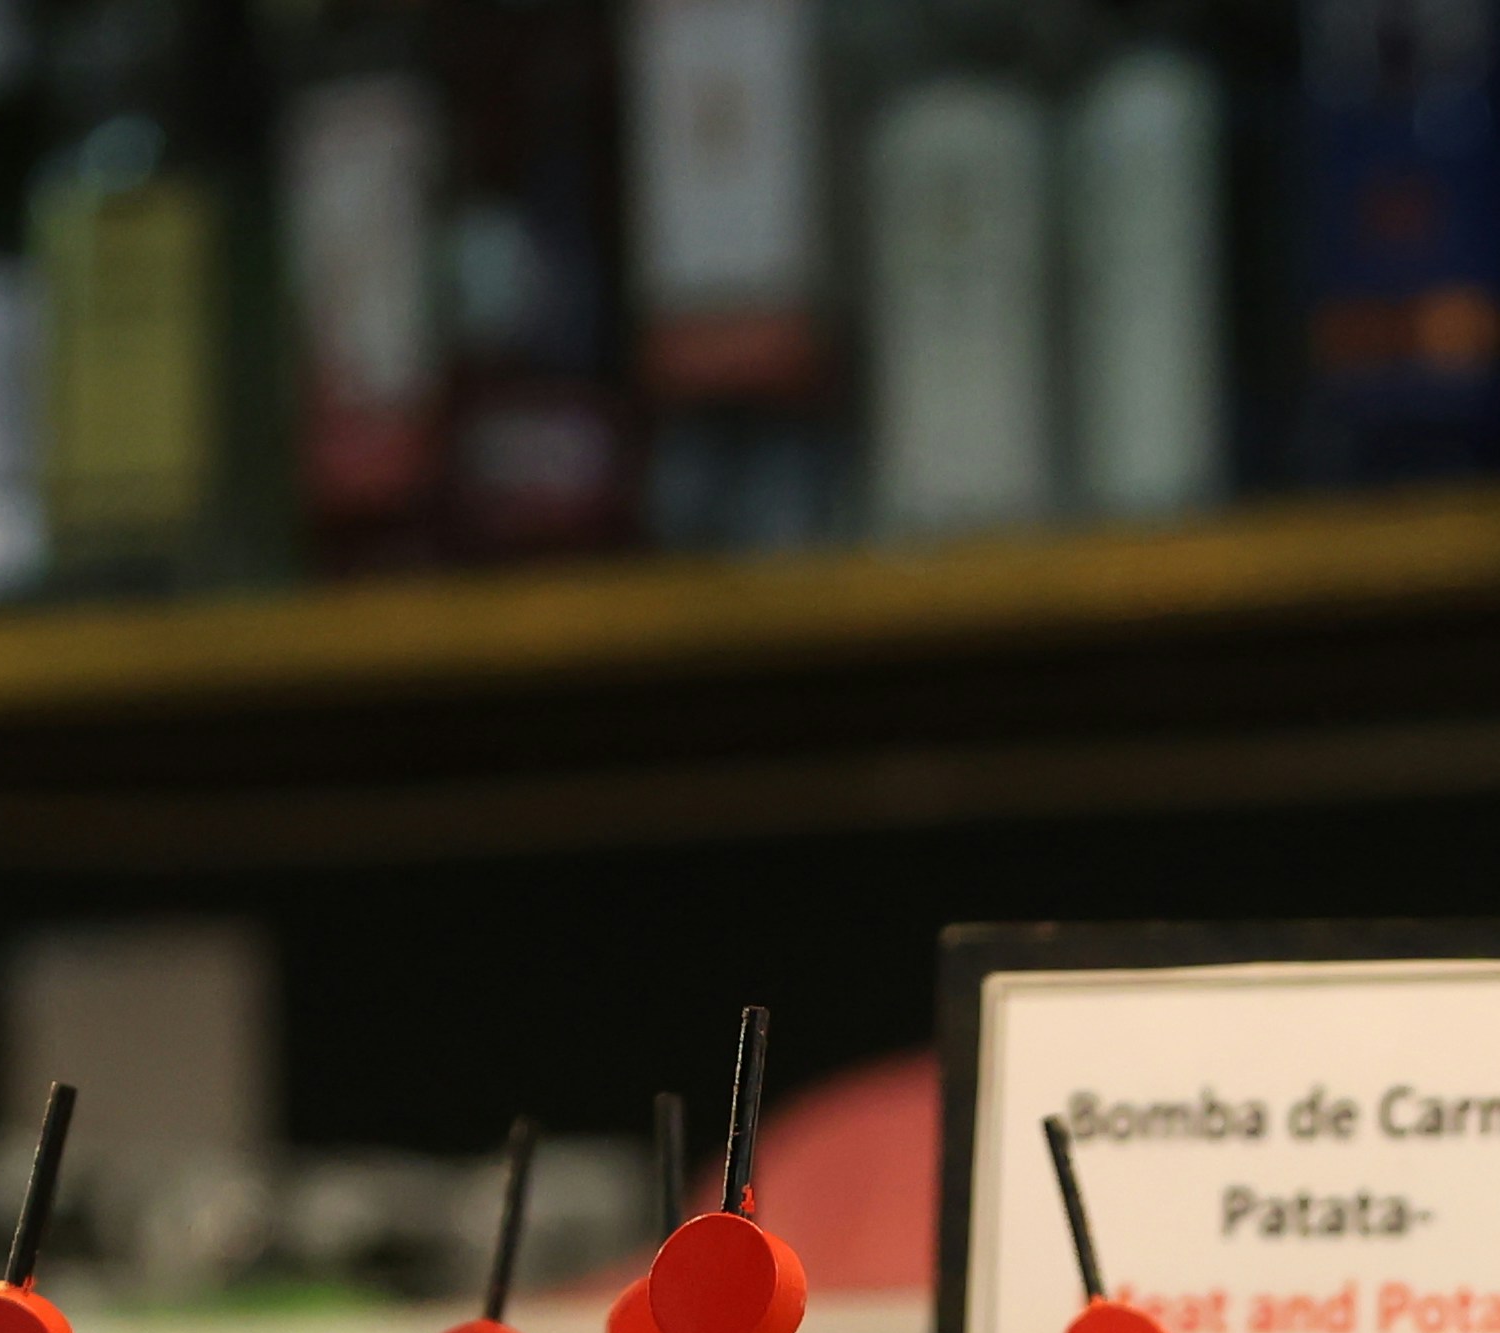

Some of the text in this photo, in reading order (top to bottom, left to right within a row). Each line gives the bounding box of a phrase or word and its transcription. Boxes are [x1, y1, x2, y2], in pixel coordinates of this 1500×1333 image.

[1069, 1088, 1270, 1141] Bomba
[1287, 1085, 1358, 1140] de
[1221, 1186, 1434, 1238] Patata-
